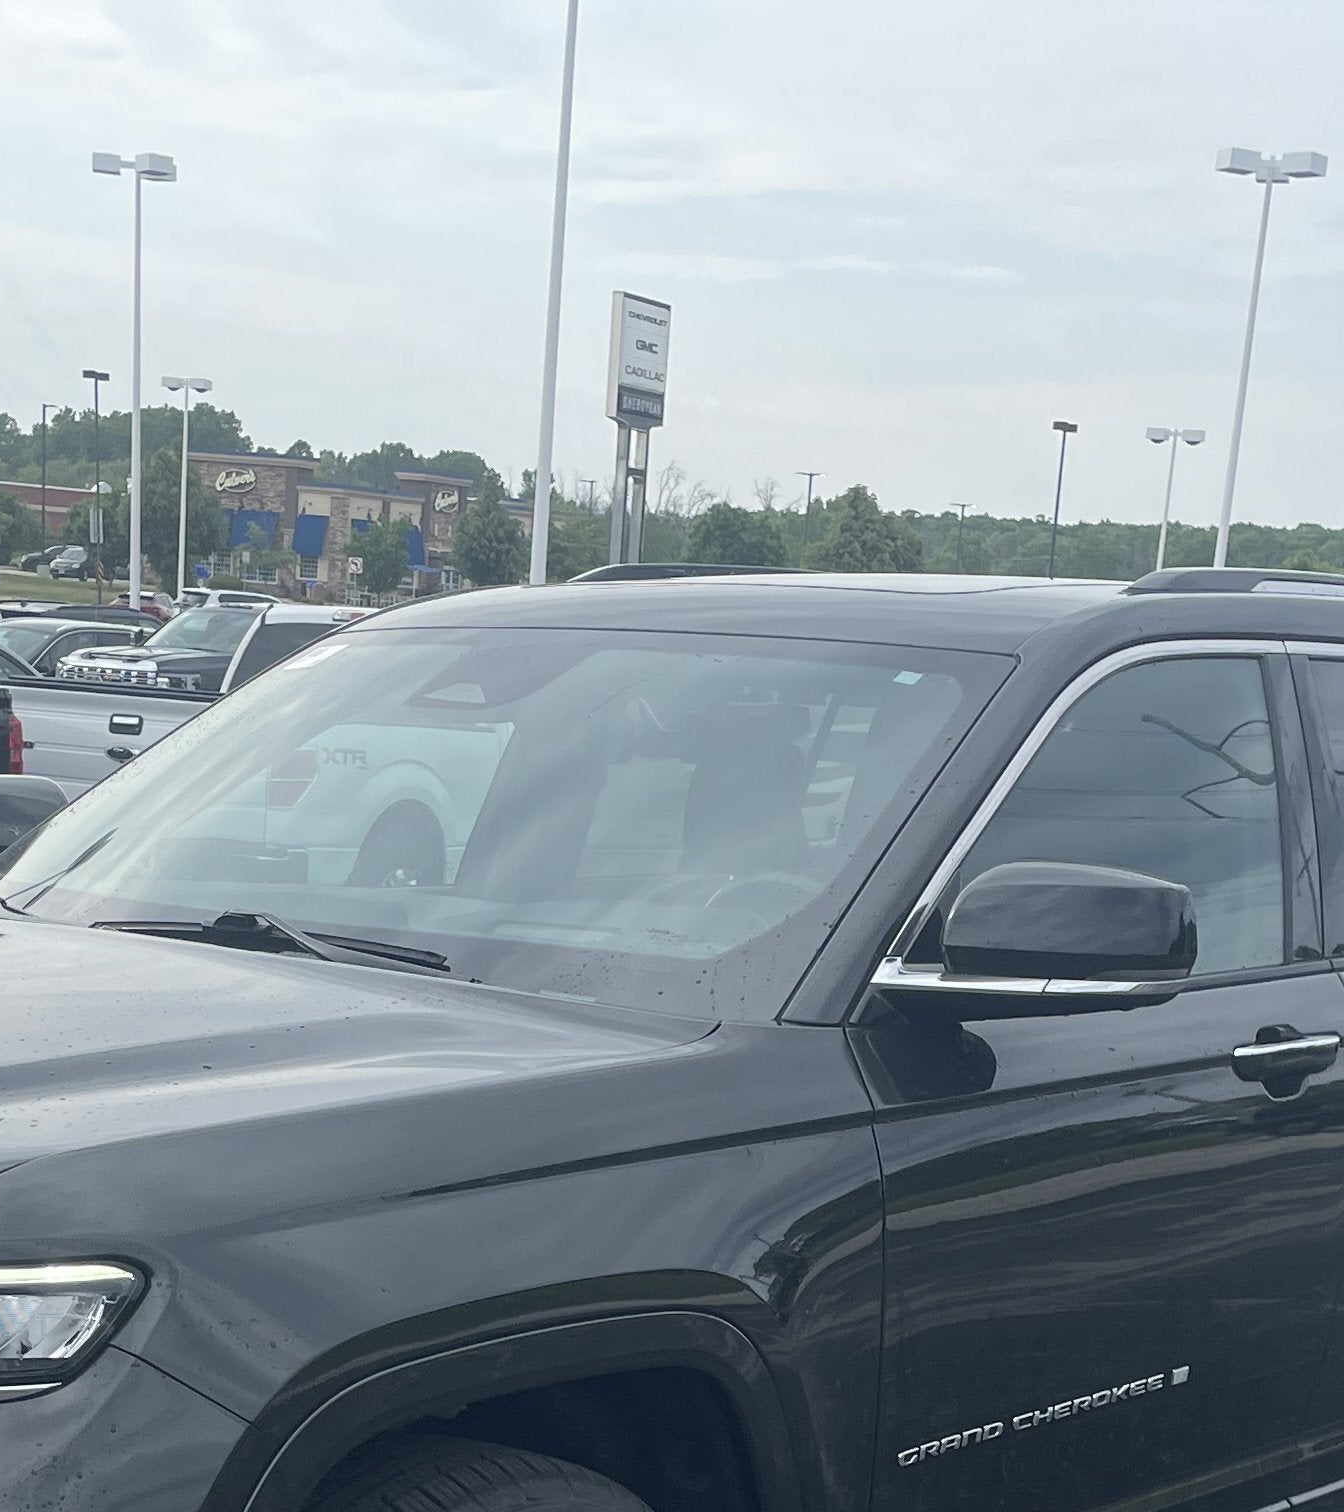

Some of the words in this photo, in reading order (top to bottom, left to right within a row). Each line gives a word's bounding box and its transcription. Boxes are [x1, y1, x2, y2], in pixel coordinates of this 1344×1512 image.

[628, 310, 668, 327] CHEVROLET
[635, 339, 659, 355] GMC
[624, 364, 665, 383] CADILLAC
[215, 469, 256, 491] Culver's
[320, 747, 368, 765] XTR
[897, 1421, 1004, 1467] GRAND
[1012, 1373, 1164, 1431] CHEROKEE
